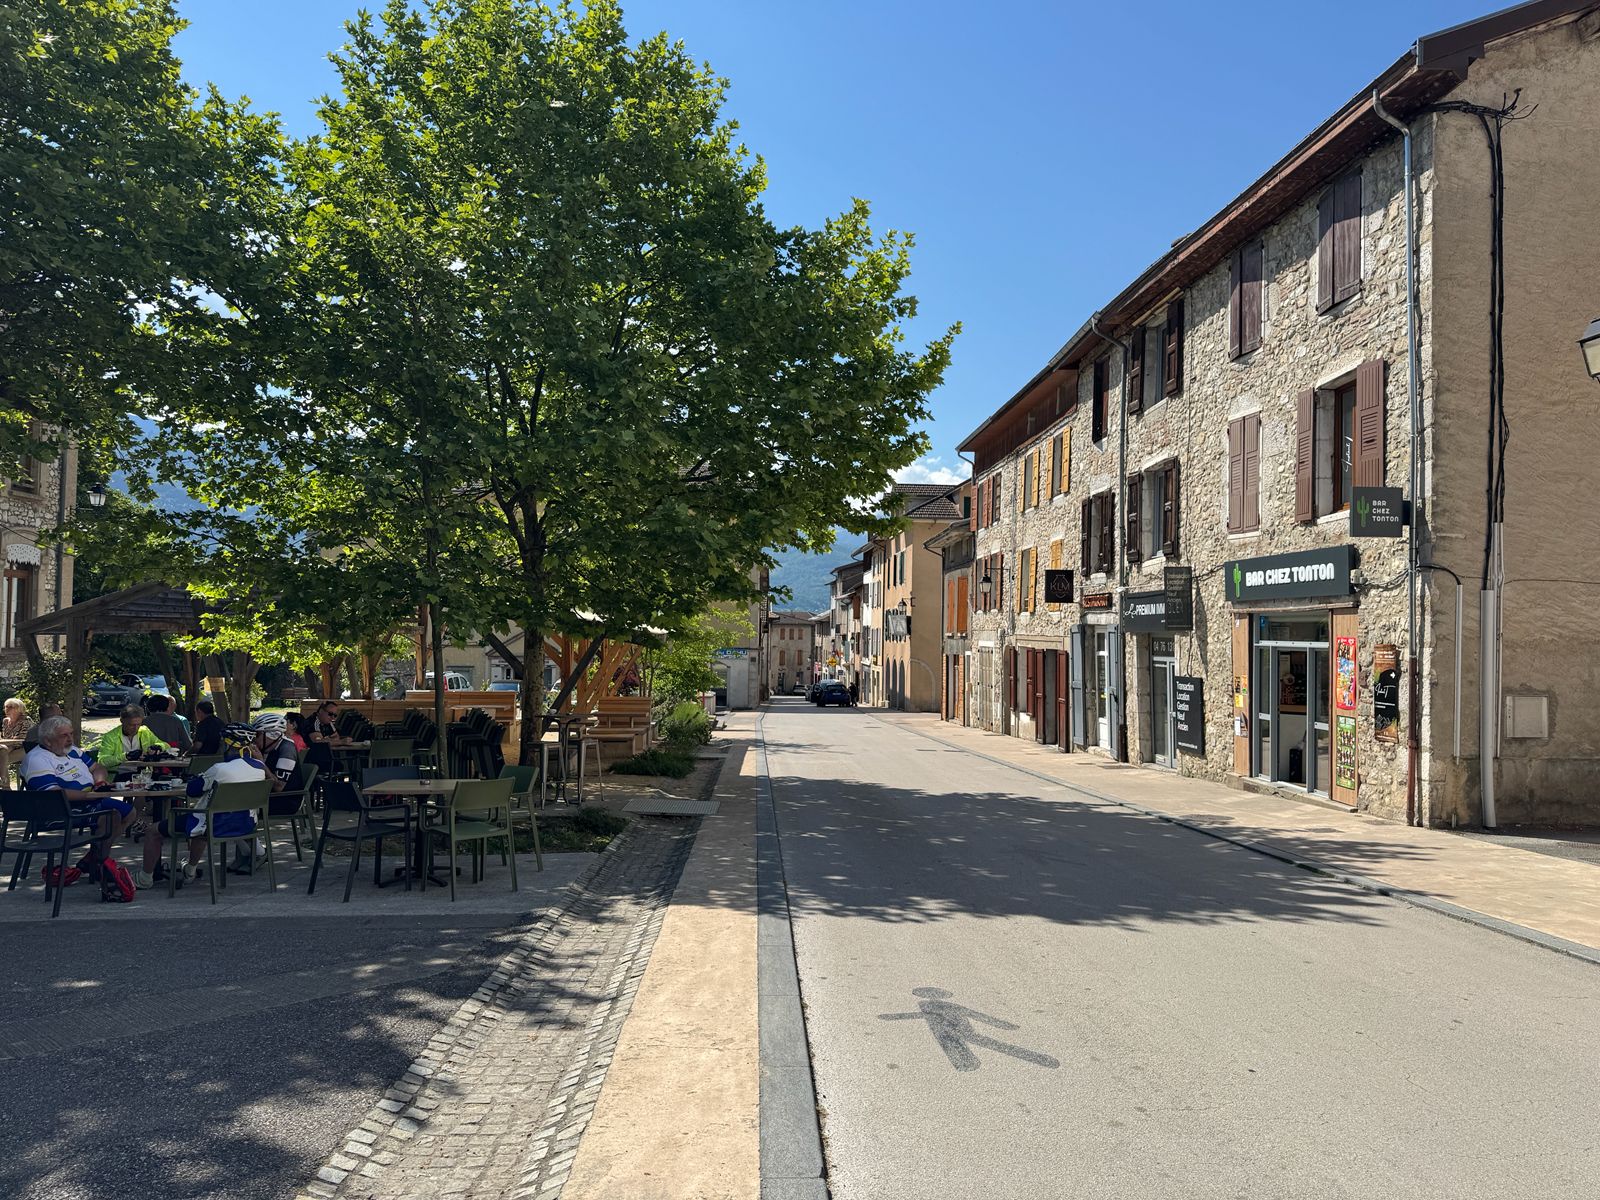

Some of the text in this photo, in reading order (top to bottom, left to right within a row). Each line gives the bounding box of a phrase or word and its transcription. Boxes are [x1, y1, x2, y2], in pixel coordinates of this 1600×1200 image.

[1245, 562, 1335, 587] BAR CHEZ TONTON
[1050, 581, 1070, 591] KLM
[1136, 603, 1155, 615] PREMIUM
[1156, 602, 1166, 615] IMM
[1176, 701, 1190, 712] Gestion
[1176, 711, 1186, 721] Neuf
